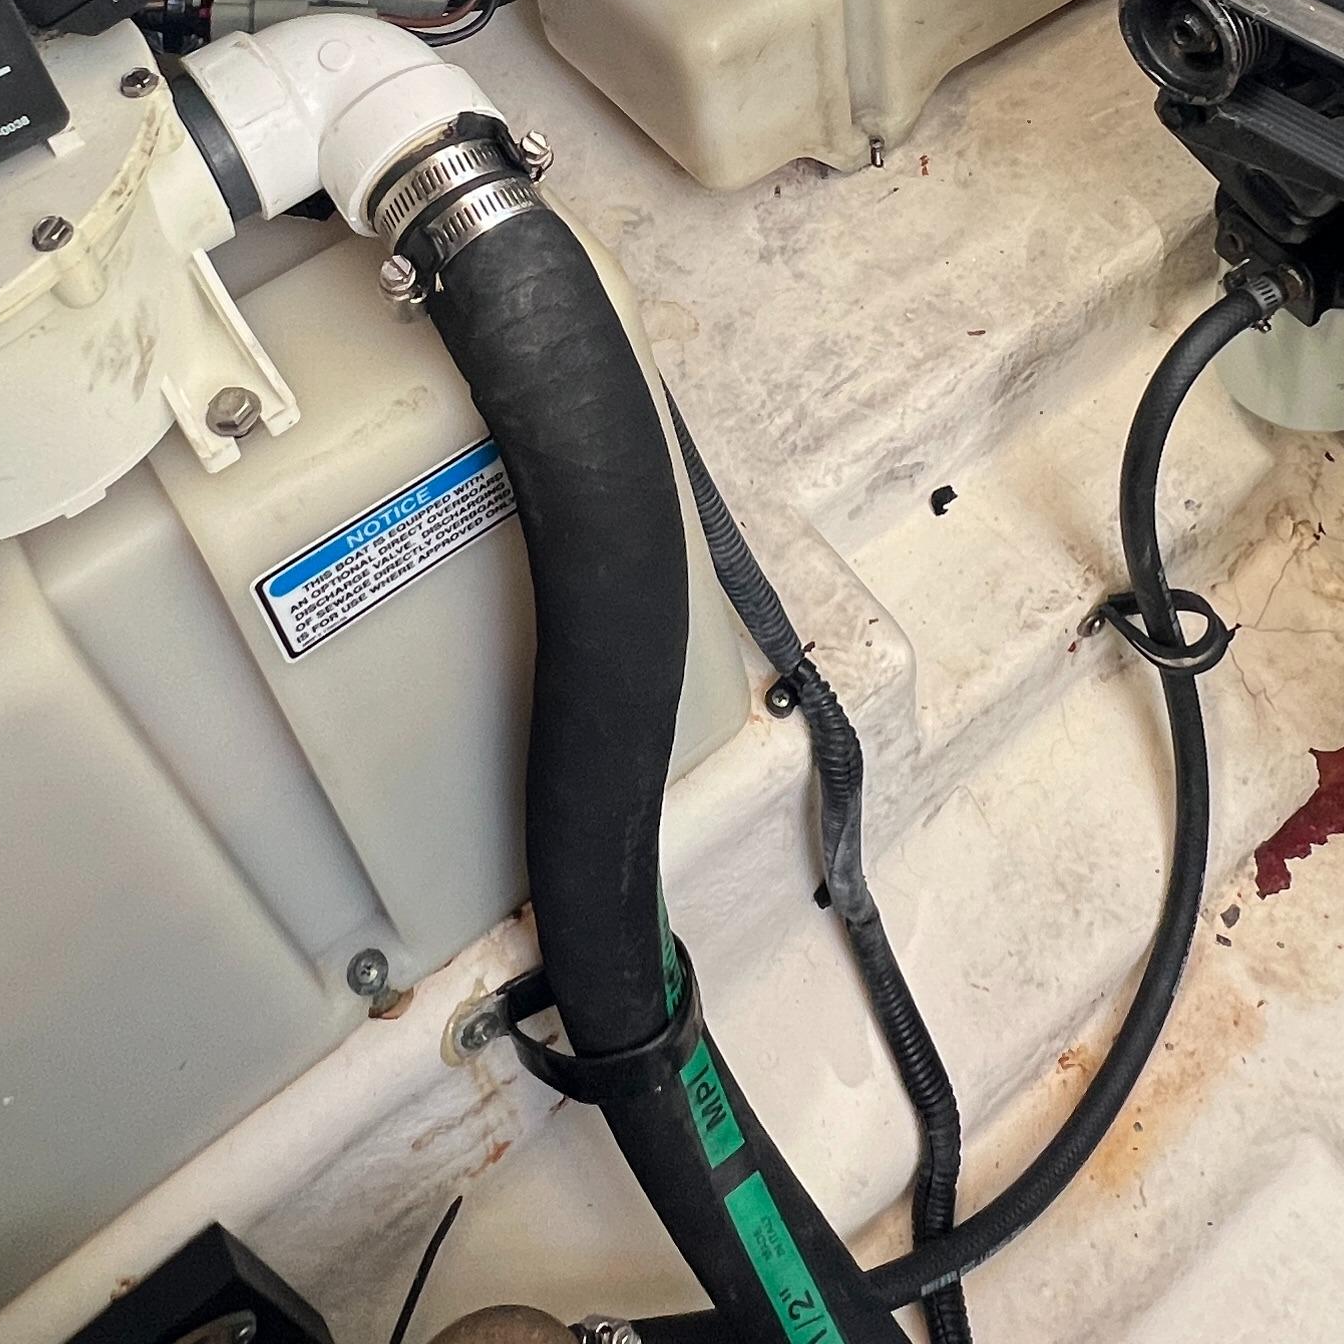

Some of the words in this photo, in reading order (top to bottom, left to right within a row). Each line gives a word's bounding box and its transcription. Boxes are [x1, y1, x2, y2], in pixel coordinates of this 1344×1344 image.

[290, 597, 308, 614] AN
[311, 556, 377, 599] OPTIONAL
[378, 522, 422, 556] DIRECT
[427, 469, 505, 524] OVERBOARD
[295, 617, 312, 632] OF
[316, 579, 371, 619] SEWAGE
[373, 538, 432, 581] DIRECTLY
[435, 486, 513, 540] OVERBOARD
[302, 570, 333, 592] THIS
[335, 545, 369, 572] BOAT
[372, 536, 386, 548] IS
[388, 494, 451, 538] EQUIPPED
[453, 472, 485, 496] WITH
[346, 486, 431, 548] NOTICE
[295, 568, 370, 622] DISCHARGE
[296, 632, 309, 643] IS
[311, 612, 339, 633] FOR
[341, 592, 368, 613] USE
[369, 561, 415, 593] WHERE
[418, 516, 483, 564] APPROVED
[687, 1064, 726, 1131] MPI
